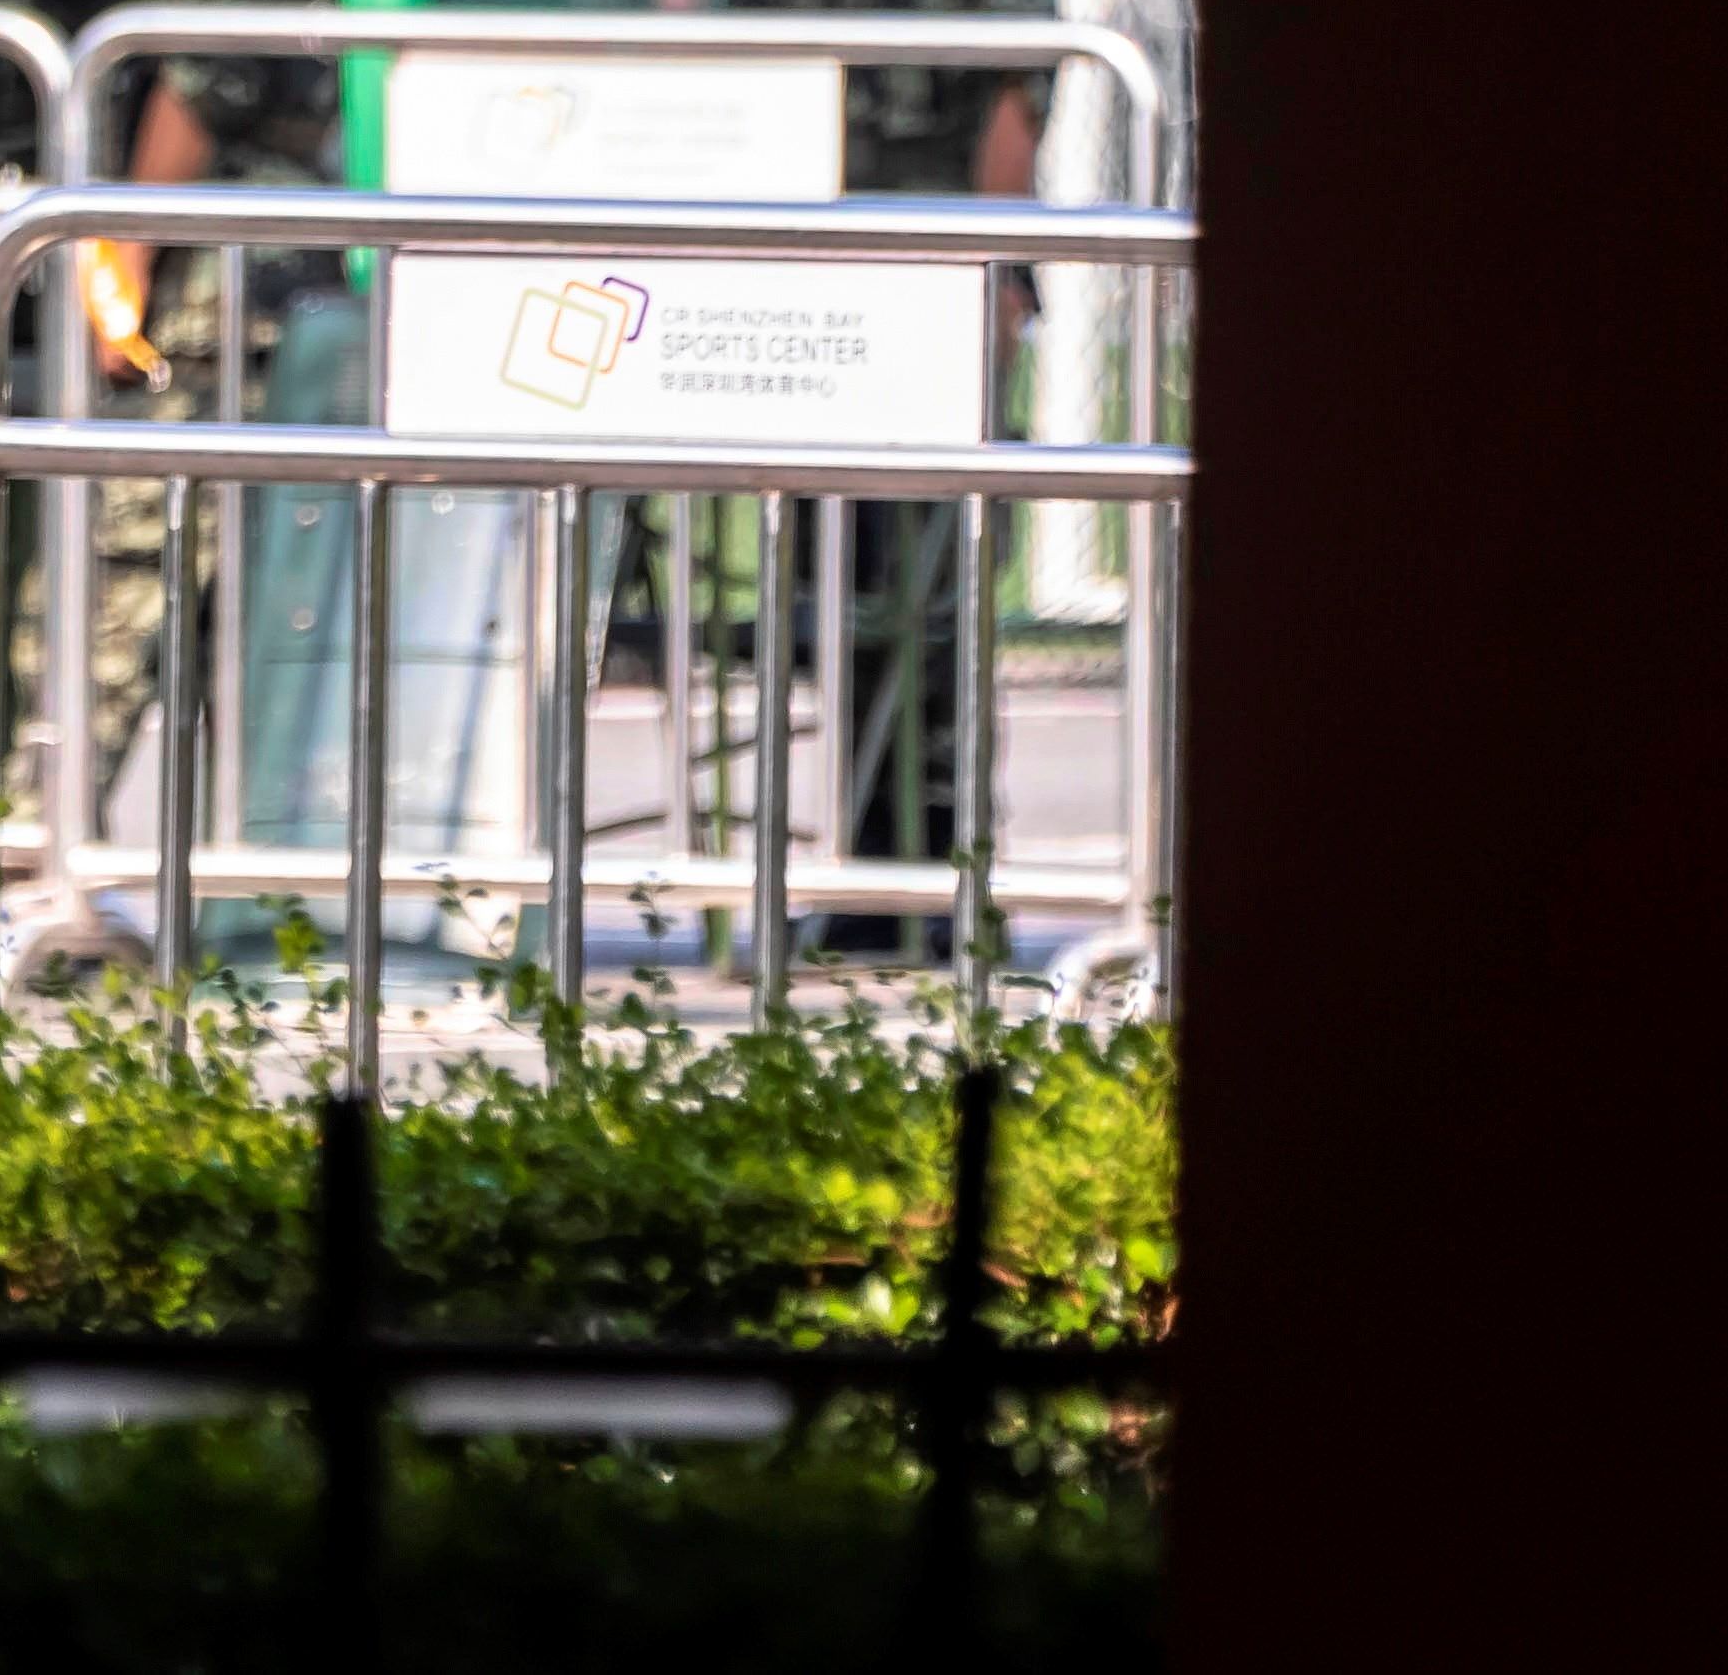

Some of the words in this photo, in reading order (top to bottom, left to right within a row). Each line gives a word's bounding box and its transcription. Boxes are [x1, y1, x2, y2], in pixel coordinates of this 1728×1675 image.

[696, 306, 814, 328] SHENZHEN
[823, 308, 865, 330] BAY
[659, 332, 761, 362] SPORTS
[766, 333, 870, 366] CENTER
